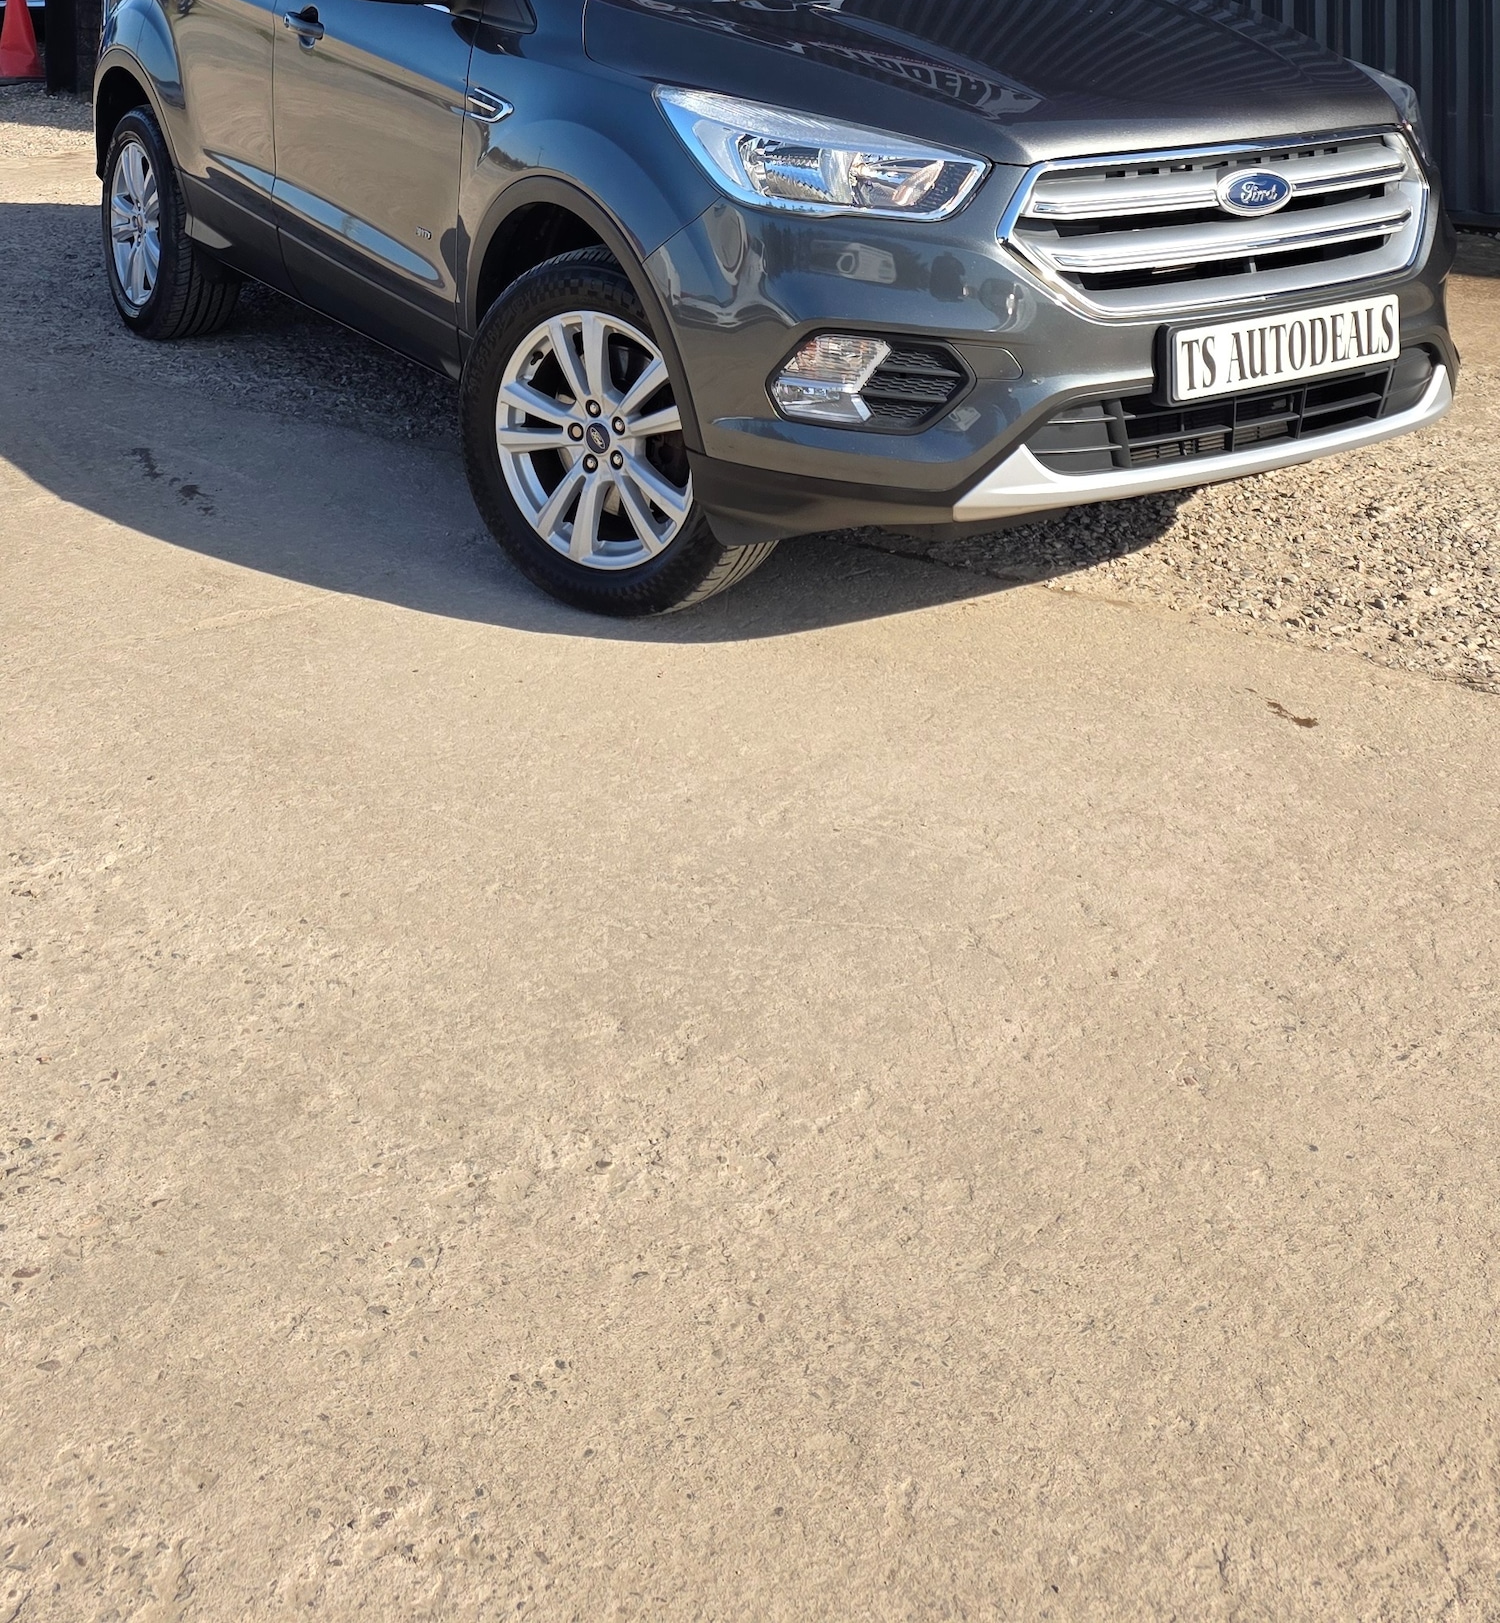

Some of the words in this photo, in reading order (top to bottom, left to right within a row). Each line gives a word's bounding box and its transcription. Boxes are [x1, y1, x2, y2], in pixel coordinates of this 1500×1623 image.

[1240, 181, 1278, 204] Ford
[1181, 337, 1216, 391] TS
[1226, 304, 1394, 384] AUTODEALS
